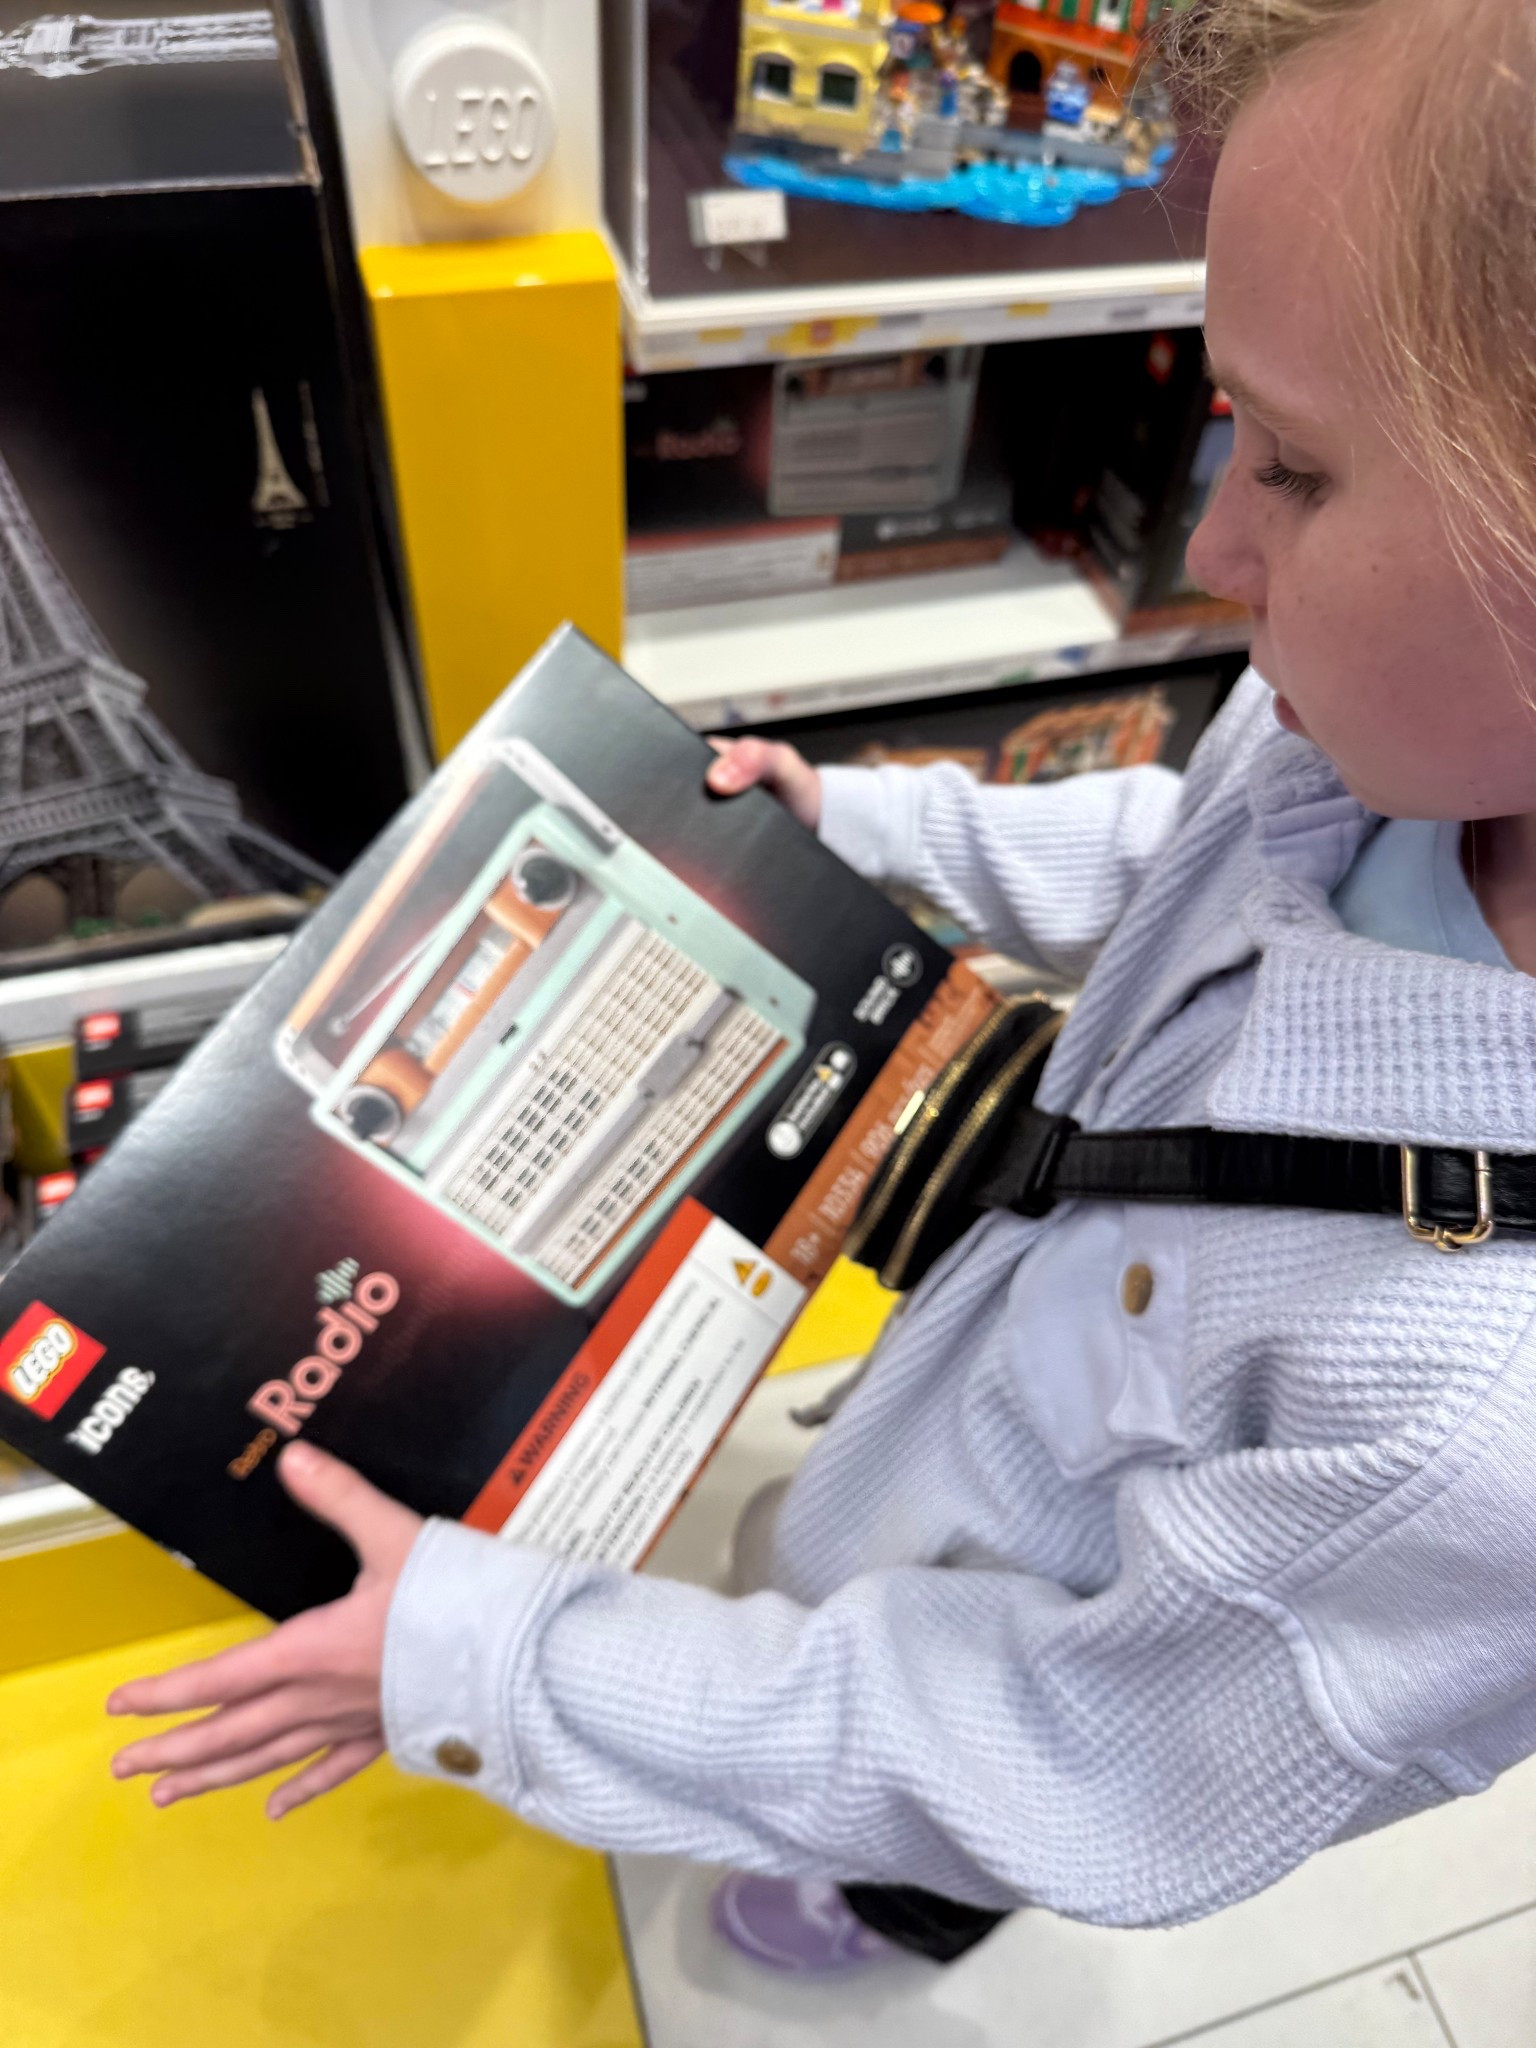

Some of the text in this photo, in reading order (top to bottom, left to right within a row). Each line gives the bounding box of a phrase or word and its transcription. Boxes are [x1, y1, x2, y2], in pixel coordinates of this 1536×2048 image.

[424, 86, 538, 171] LEGO
[9, 1320, 77, 1402] LEGO
[246, 1271, 399, 1437] Radio
[520, 1373, 591, 1465] WARNING
